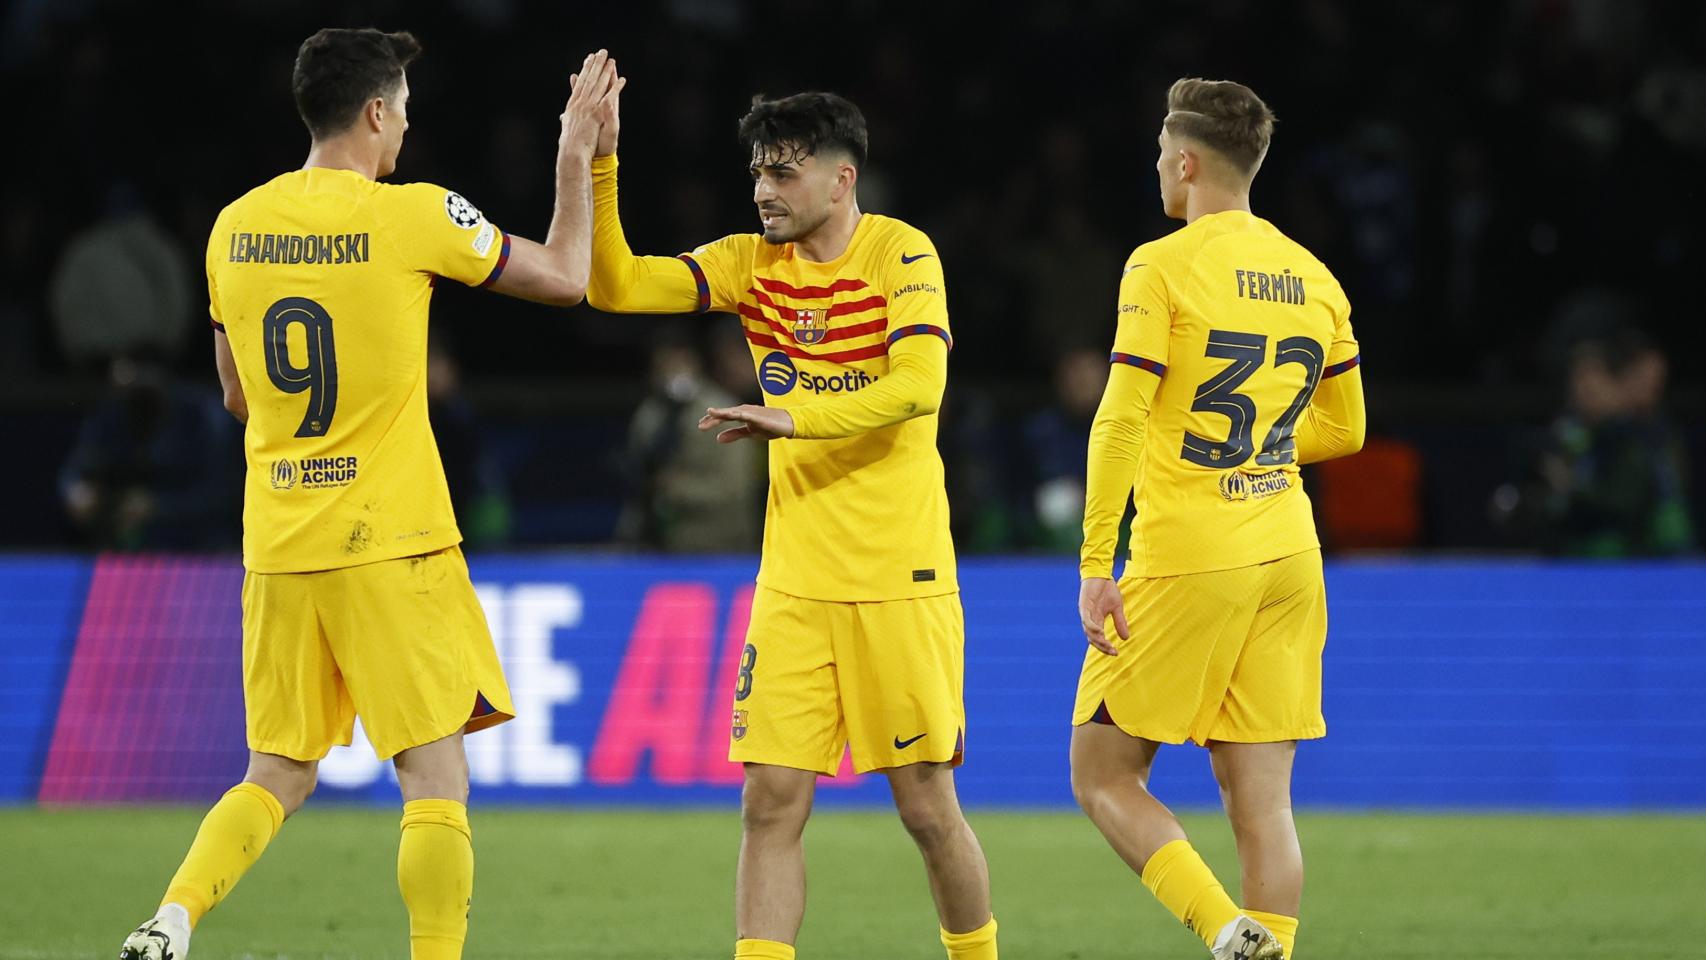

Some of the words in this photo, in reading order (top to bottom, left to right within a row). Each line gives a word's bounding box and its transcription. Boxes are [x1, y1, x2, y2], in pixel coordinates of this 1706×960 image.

[229, 232, 369, 264] LEWANDOWSKI
[1235, 268, 1306, 306] FERMÍN
[262, 296, 339, 438] 9
[1180, 329, 1325, 469] 32
[301, 457, 357, 471] UNHCR
[301, 469, 357, 483] ACNUR
[1251, 478, 1290, 495] ACNUR
[735, 643, 758, 702] 8
